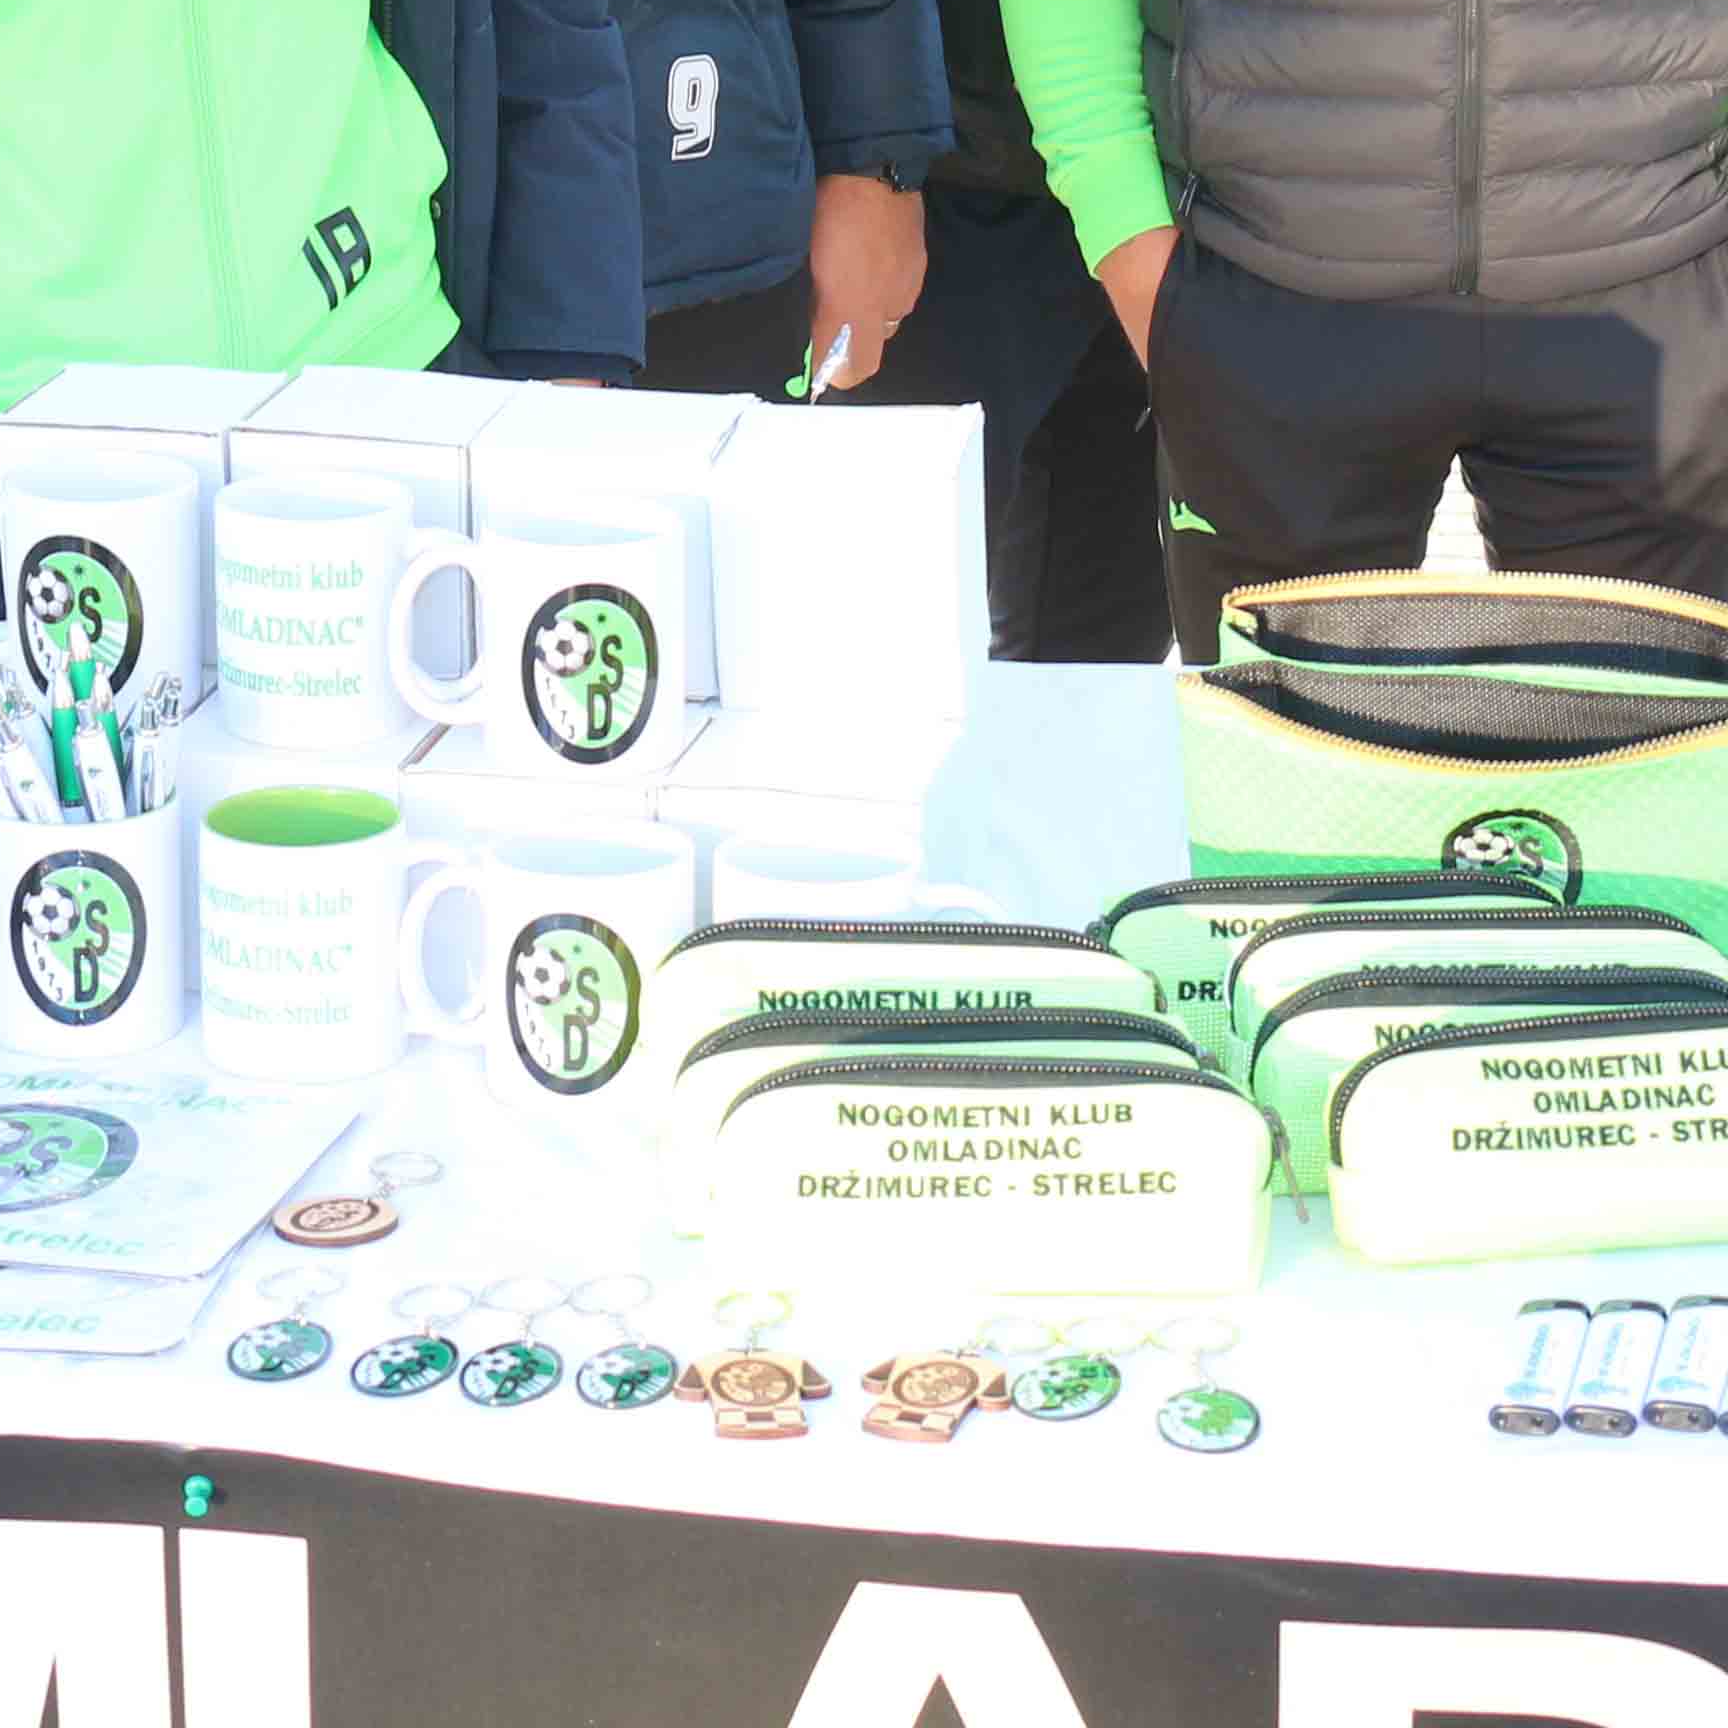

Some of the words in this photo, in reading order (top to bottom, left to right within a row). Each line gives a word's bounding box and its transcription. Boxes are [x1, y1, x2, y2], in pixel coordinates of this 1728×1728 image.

[667, 53, 719, 160] 9
[757, 990, 939, 1011] NOGOMETNI
[1481, 1052, 1663, 1080] NOGOMETNI
[1534, 1083, 1715, 1114] OMLADINAC
[837, 1102, 1032, 1127] NOGOMETNI
[1050, 1103, 1134, 1126] KLUB
[888, 1137, 1083, 1162] OMLADINAC
[1453, 1121, 1637, 1152] DRŽIMUREC
[797, 1170, 993, 1199] DRŽIMUREC
[1032, 1171, 1177, 1197] STRELEC
